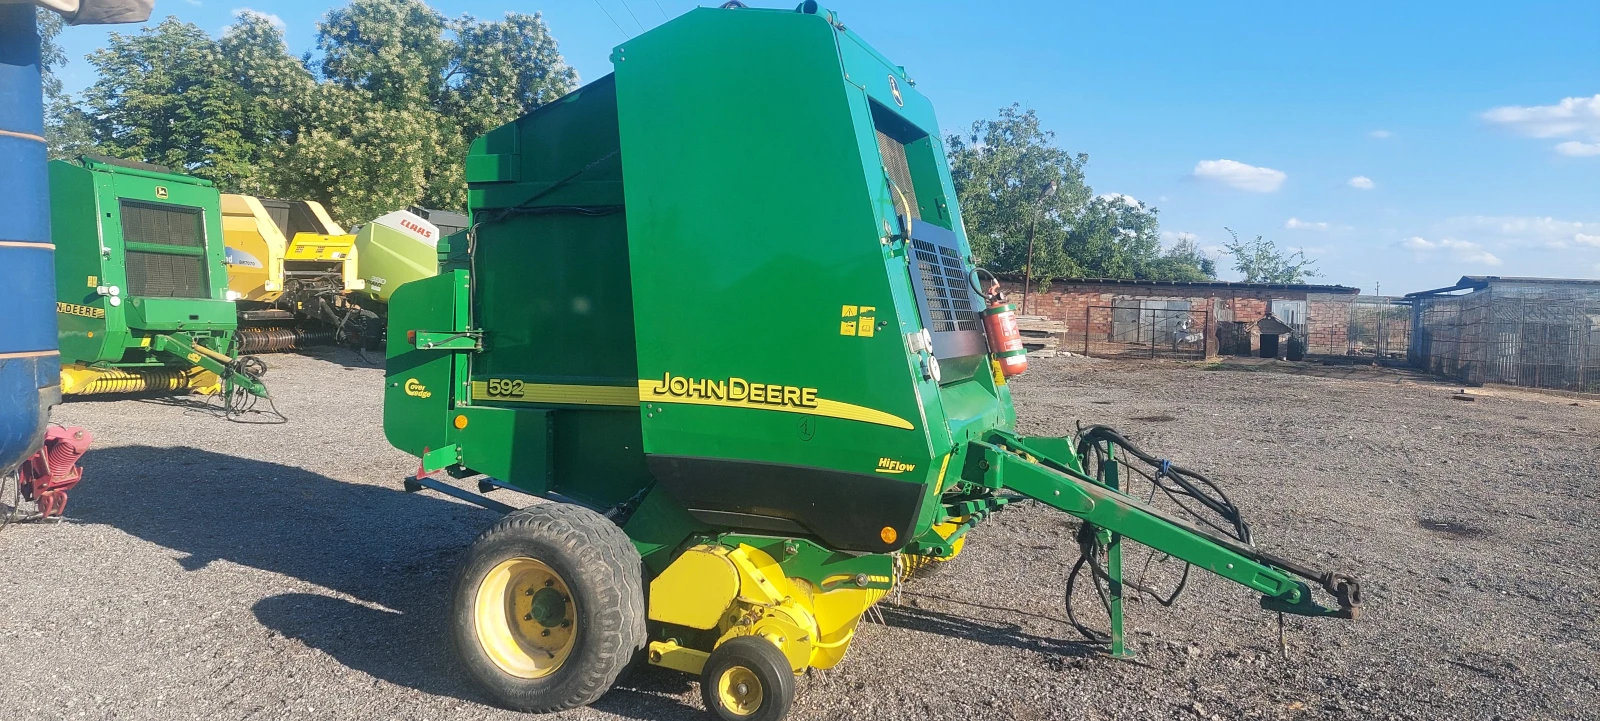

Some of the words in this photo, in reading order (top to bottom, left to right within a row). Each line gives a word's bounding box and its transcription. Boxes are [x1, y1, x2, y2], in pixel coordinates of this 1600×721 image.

[400, 219, 432, 238] CLAAS
[65, 304, 98, 318] DEERE
[487, 378, 525, 398] 592
[654, 372, 725, 399] JOHN
[727, 377, 818, 408] DEERE
[878, 457, 916, 472] HiFlow
